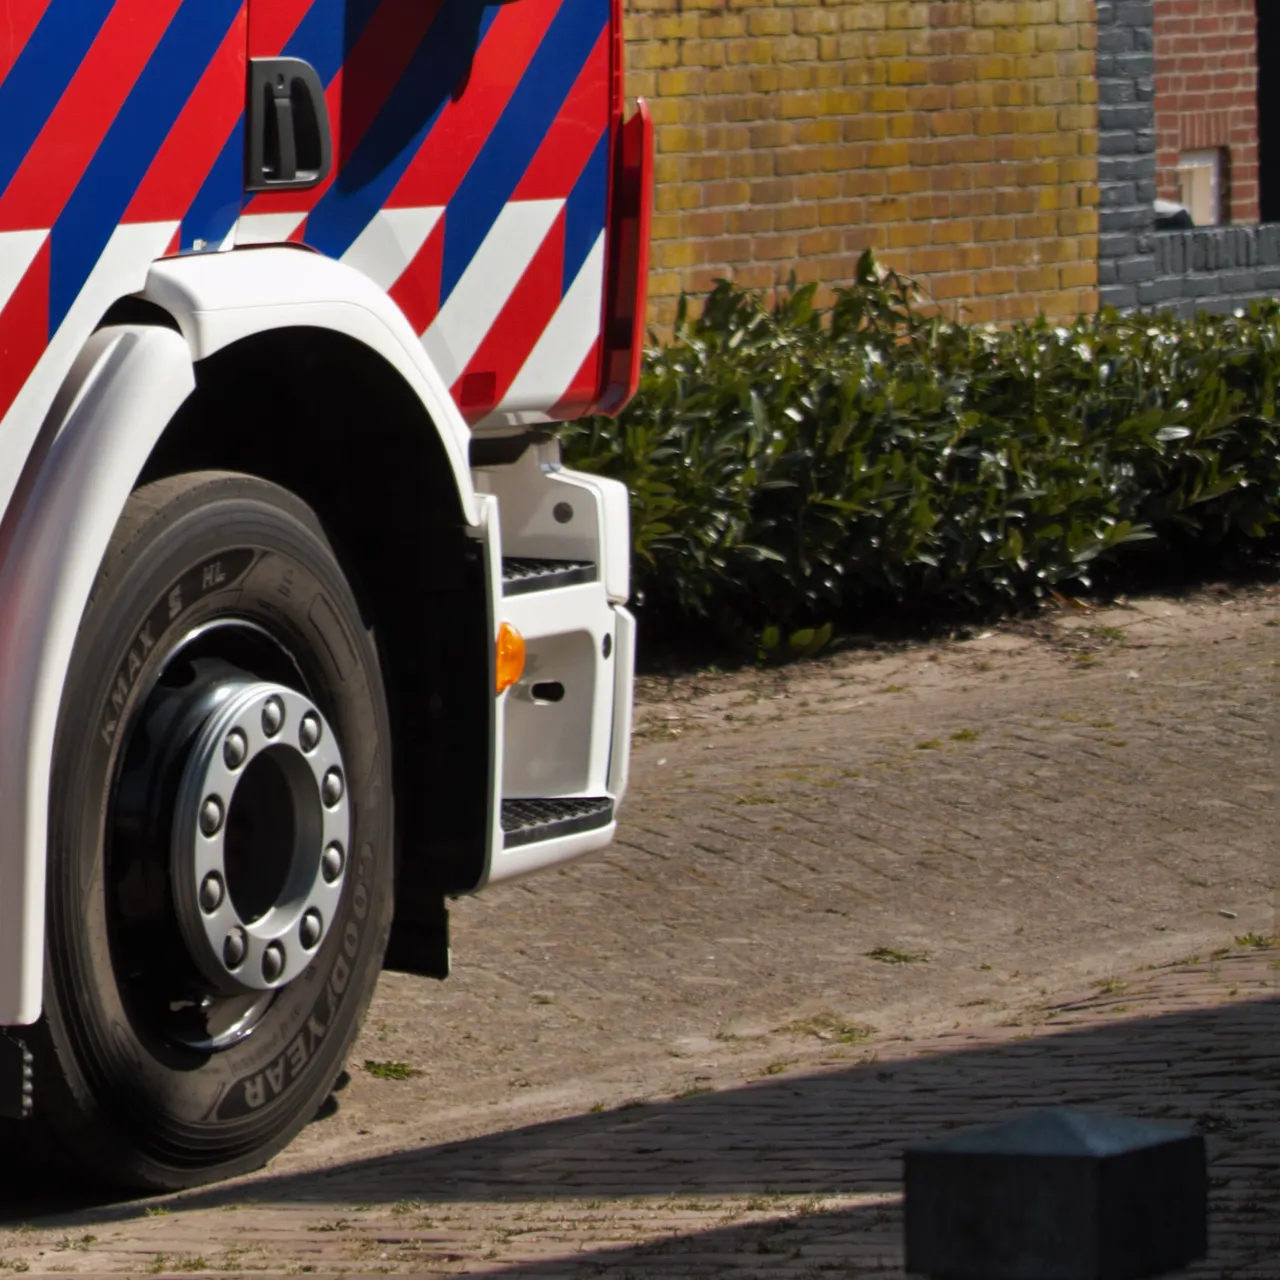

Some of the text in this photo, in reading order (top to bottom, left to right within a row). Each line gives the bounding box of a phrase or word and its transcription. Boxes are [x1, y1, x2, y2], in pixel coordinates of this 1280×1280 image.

[101, 561, 227, 747] KMAX S HL
[243, 841, 375, 1110] GOODYEAR
